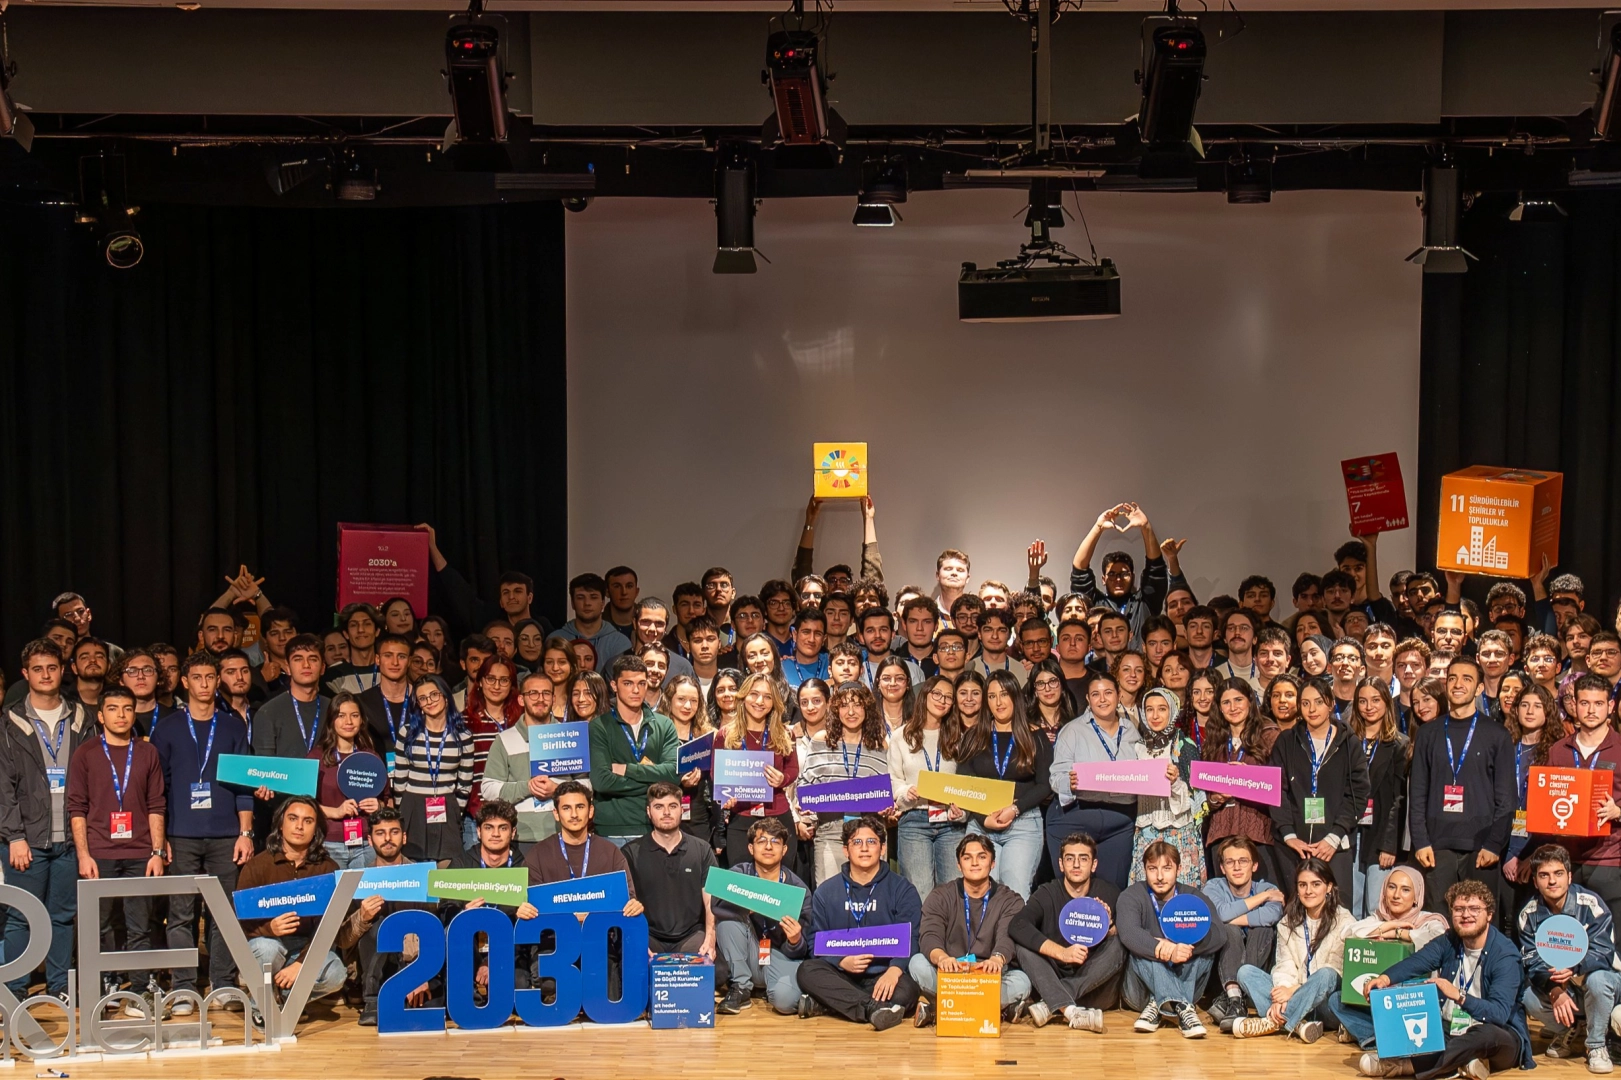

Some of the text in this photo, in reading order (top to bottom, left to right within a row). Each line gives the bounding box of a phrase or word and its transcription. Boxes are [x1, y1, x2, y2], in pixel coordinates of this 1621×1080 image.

[1352, 501, 1360, 513] 7
[1450, 494, 1465, 512] 11
[1469, 495, 1519, 508] SÜRDÜRÜLEBİLİR
[1468, 506, 1505, 517] ŞEHİRLER VE
[1468, 516, 1509, 527] TOPLULUKLAR
[368, 558, 398, 567] 2030'a
[537, 731, 566, 739] Gelecek
[542, 740, 577, 750] Birlikte
[725, 758, 764, 768] Bursiyer
[247, 768, 288, 780] #SuyuKoru
[1095, 773, 1149, 782] #HerkeseAnlat
[1198, 772, 1273, 792] #KendinİçinBirŞeyYap
[1538, 773, 1546, 788] 5
[734, 786, 767, 794] RÖNESANS
[943, 786, 987, 801] #Hedef2030
[801, 789, 891, 805] #HepBirlikteBaşarabiliriz
[358, 879, 421, 890] DünyaHepimizin
[433, 880, 523, 893] #GezegenİçinBirŞeyYap
[257, 893, 316, 909] #İyilikBüyüsün
[553, 890, 606, 904] #REVakademi
[726, 883, 781, 907] #GezegeniKoru
[1069, 911, 1101, 922] RÖNESANS
[826, 936, 899, 948] #GelecekİçinBirlikte
[1347, 947, 1361, 962] 13
[377, 907, 649, 1033] 2030
[655, 990, 669, 1001] 12
[1395, 992, 1409, 1001] TEMİZ
[941, 998, 954, 1009] 10
[1383, 995, 1392, 1010] 6
[0, 963, 273, 1060] demi
